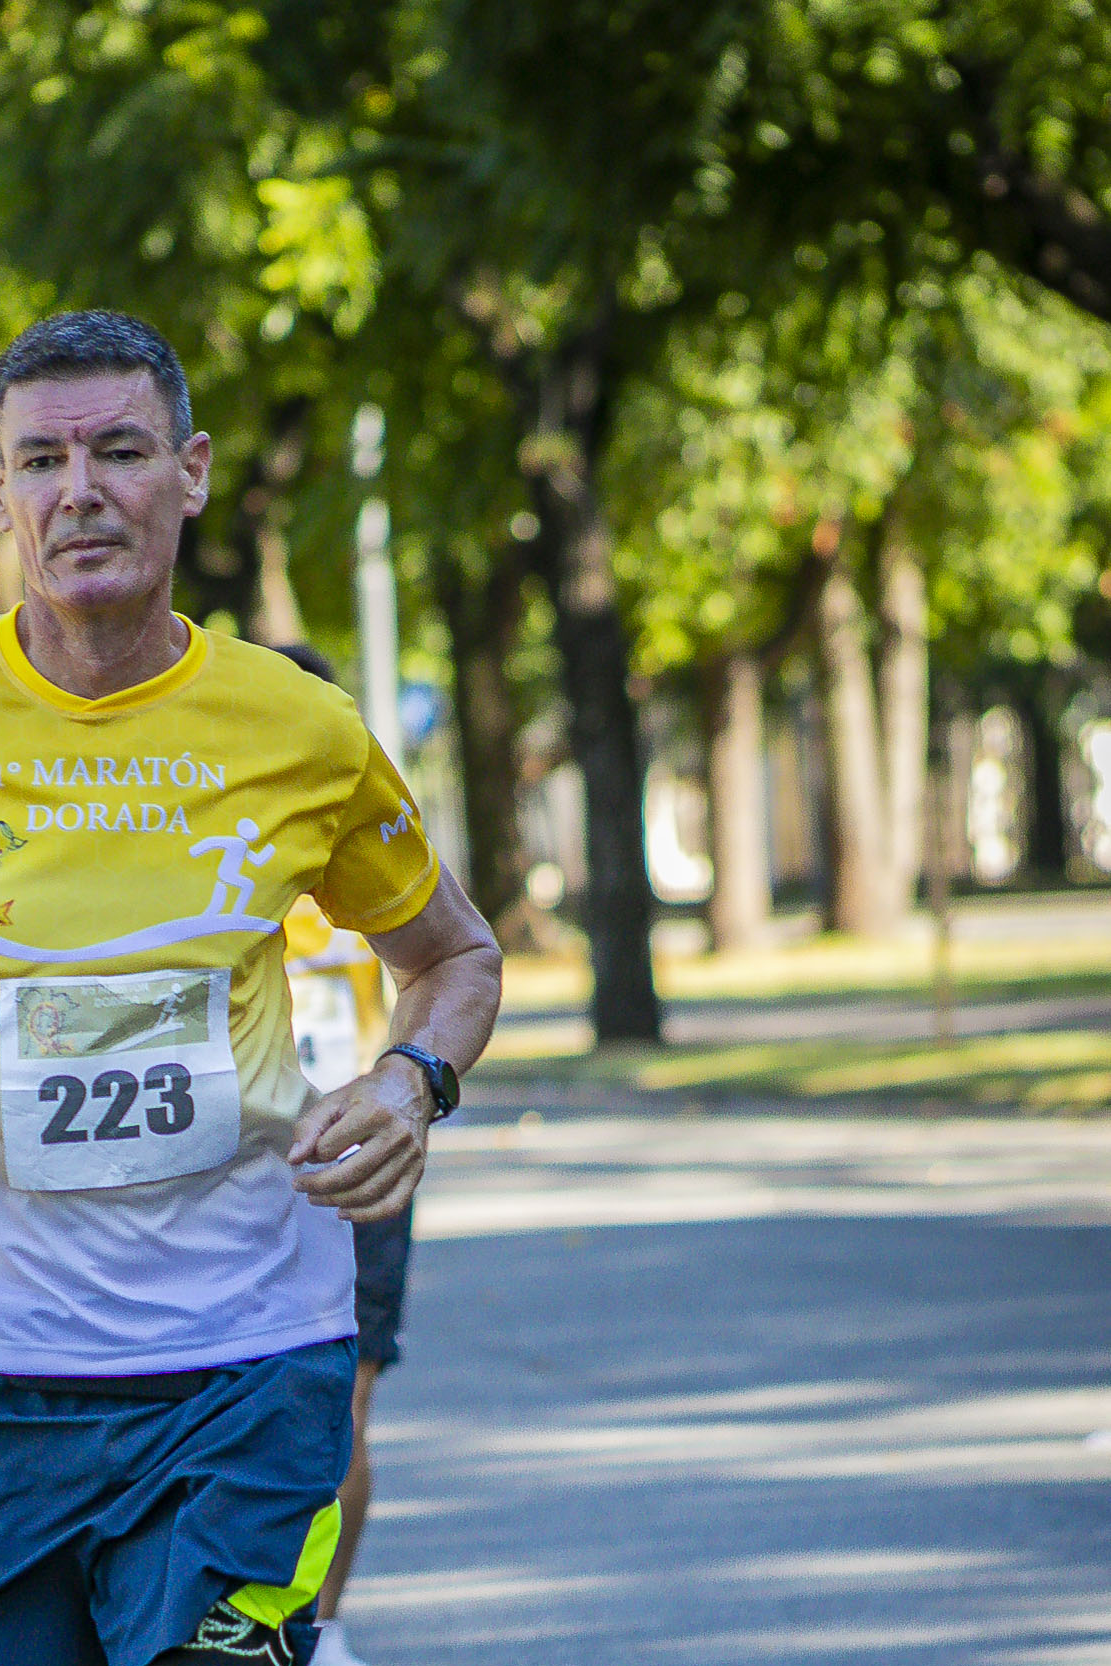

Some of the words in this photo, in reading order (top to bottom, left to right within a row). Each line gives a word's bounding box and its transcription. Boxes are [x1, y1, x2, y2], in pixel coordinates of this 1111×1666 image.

[31, 751, 226, 791] MARATÓN
[26, 802, 192, 835] DORADA
[38, 1062, 195, 1145] 223
